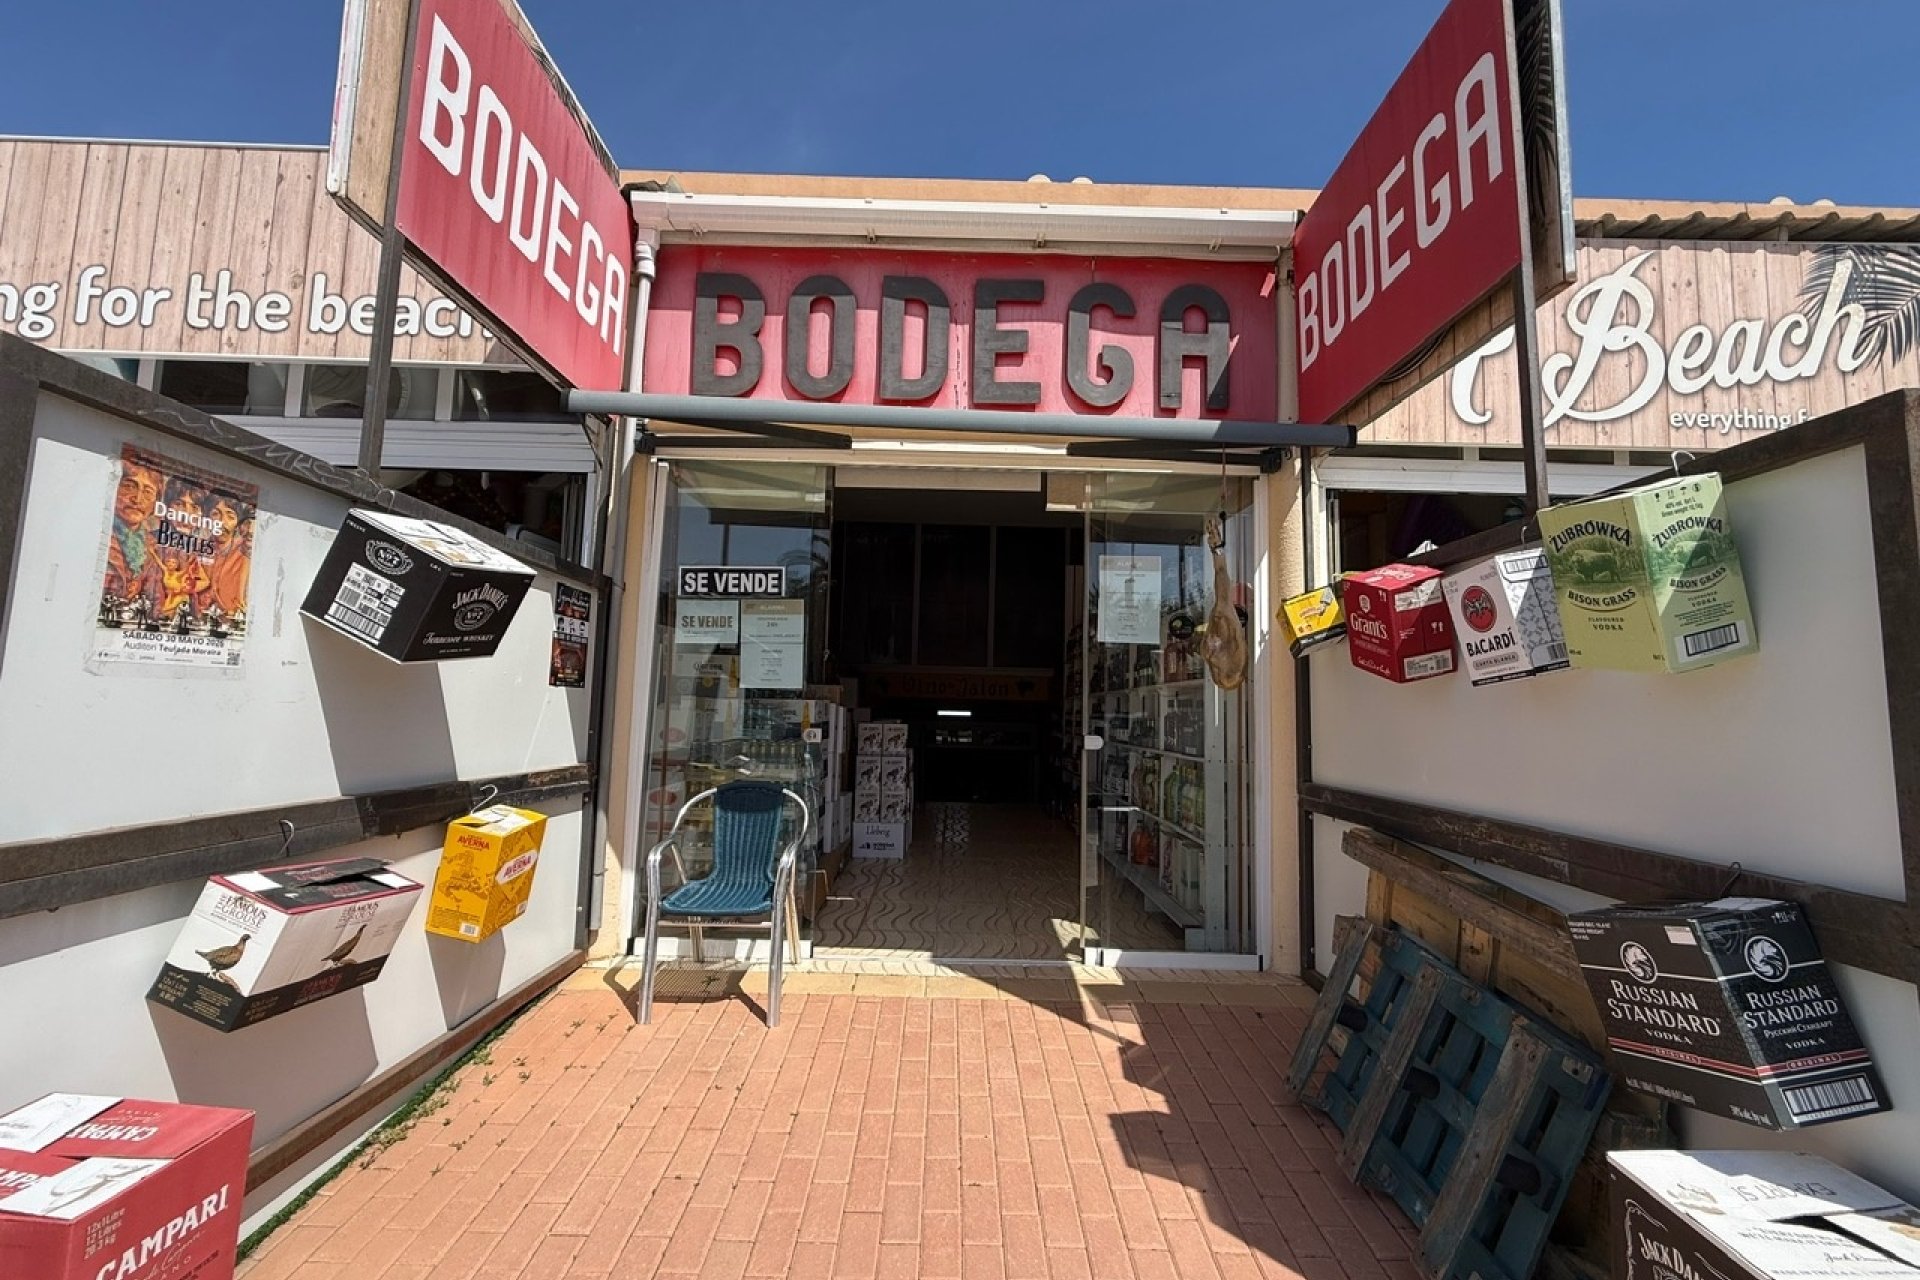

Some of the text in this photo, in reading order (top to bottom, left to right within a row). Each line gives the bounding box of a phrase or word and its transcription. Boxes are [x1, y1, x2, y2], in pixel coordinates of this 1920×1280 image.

[419, 12, 626, 356] BODEGA
[1299, 50, 1504, 374] BODEGA
[74, 265, 172, 327] for
[186, 269, 292, 332] the
[694, 271, 1232, 411] BODEGA
[1543, 250, 1880, 429] Beach
[1669, 408, 1792, 435] everything
[154, 501, 224, 537] Dancing
[157, 519, 215, 556] BEATLES
[683, 572, 779, 593] SE VENDE
[1669, 566, 1726, 590] BISON GRASS
[1567, 588, 1636, 607] BISON GRASS
[681, 615, 733, 628] SE VENDE
[1350, 612, 1388, 640] Grant's
[1592, 623, 1624, 631] VODKA
[178, 635, 204, 646] MAYO
[1466, 626, 1516, 657] BACARDÍ
[457, 836, 490, 850] AVERNA
[1610, 978, 1699, 1011] RUSSIAN
[1745, 984, 1822, 1010] RUSSIAN
[1607, 997, 1721, 1037] STANDARD
[1742, 999, 1839, 1030] STANDARD
[1645, 1027, 1693, 1045] VODKA
[1785, 1037, 1825, 1049] VODKA
[97, 1183, 229, 1280] CAMPARI
[1638, 1231, 1674, 1269] JACK
